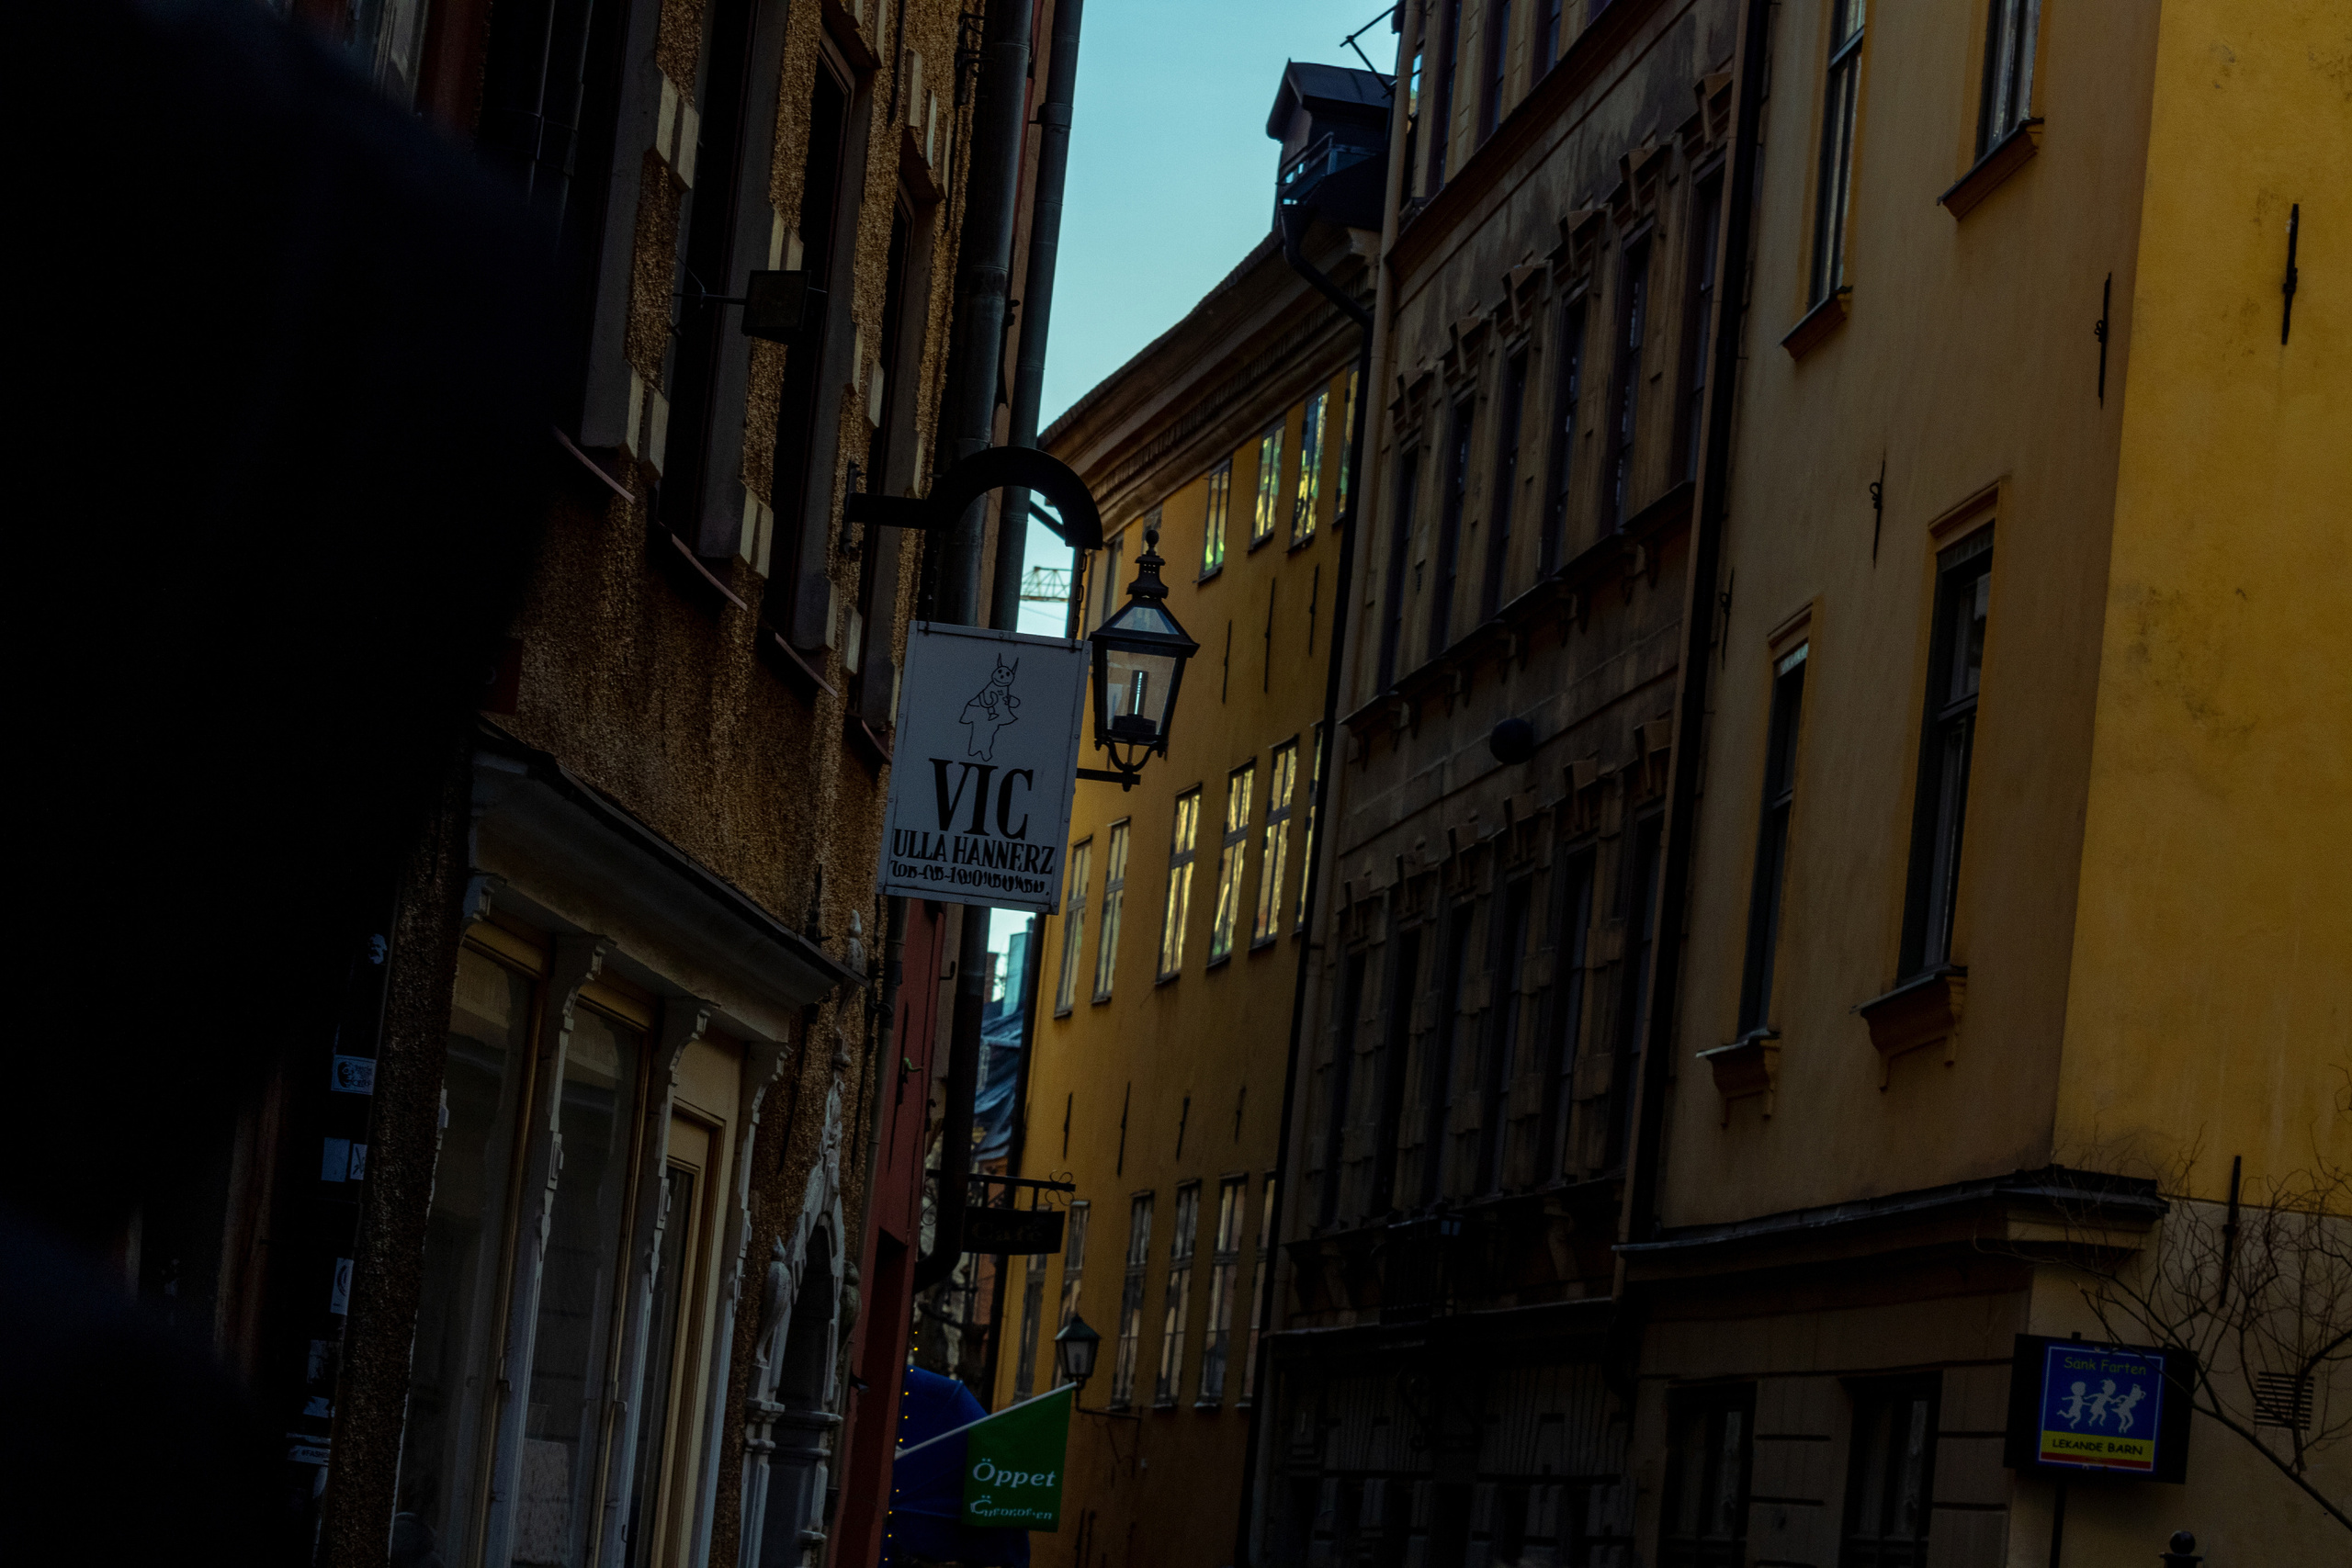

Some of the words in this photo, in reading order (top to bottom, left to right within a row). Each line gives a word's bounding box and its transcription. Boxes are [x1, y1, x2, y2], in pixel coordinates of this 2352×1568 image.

[929, 758, 1033, 840] VIC
[893, 829, 947, 862] ULLA
[953, 836, 1056, 874] HANNERZ
[2101, 1359, 2147, 1375] Farten
[2052, 1438, 2103, 1452] LEKANDE
[2108, 1443, 2143, 1455] BARN
[972, 1458, 1057, 1488] Öppet
